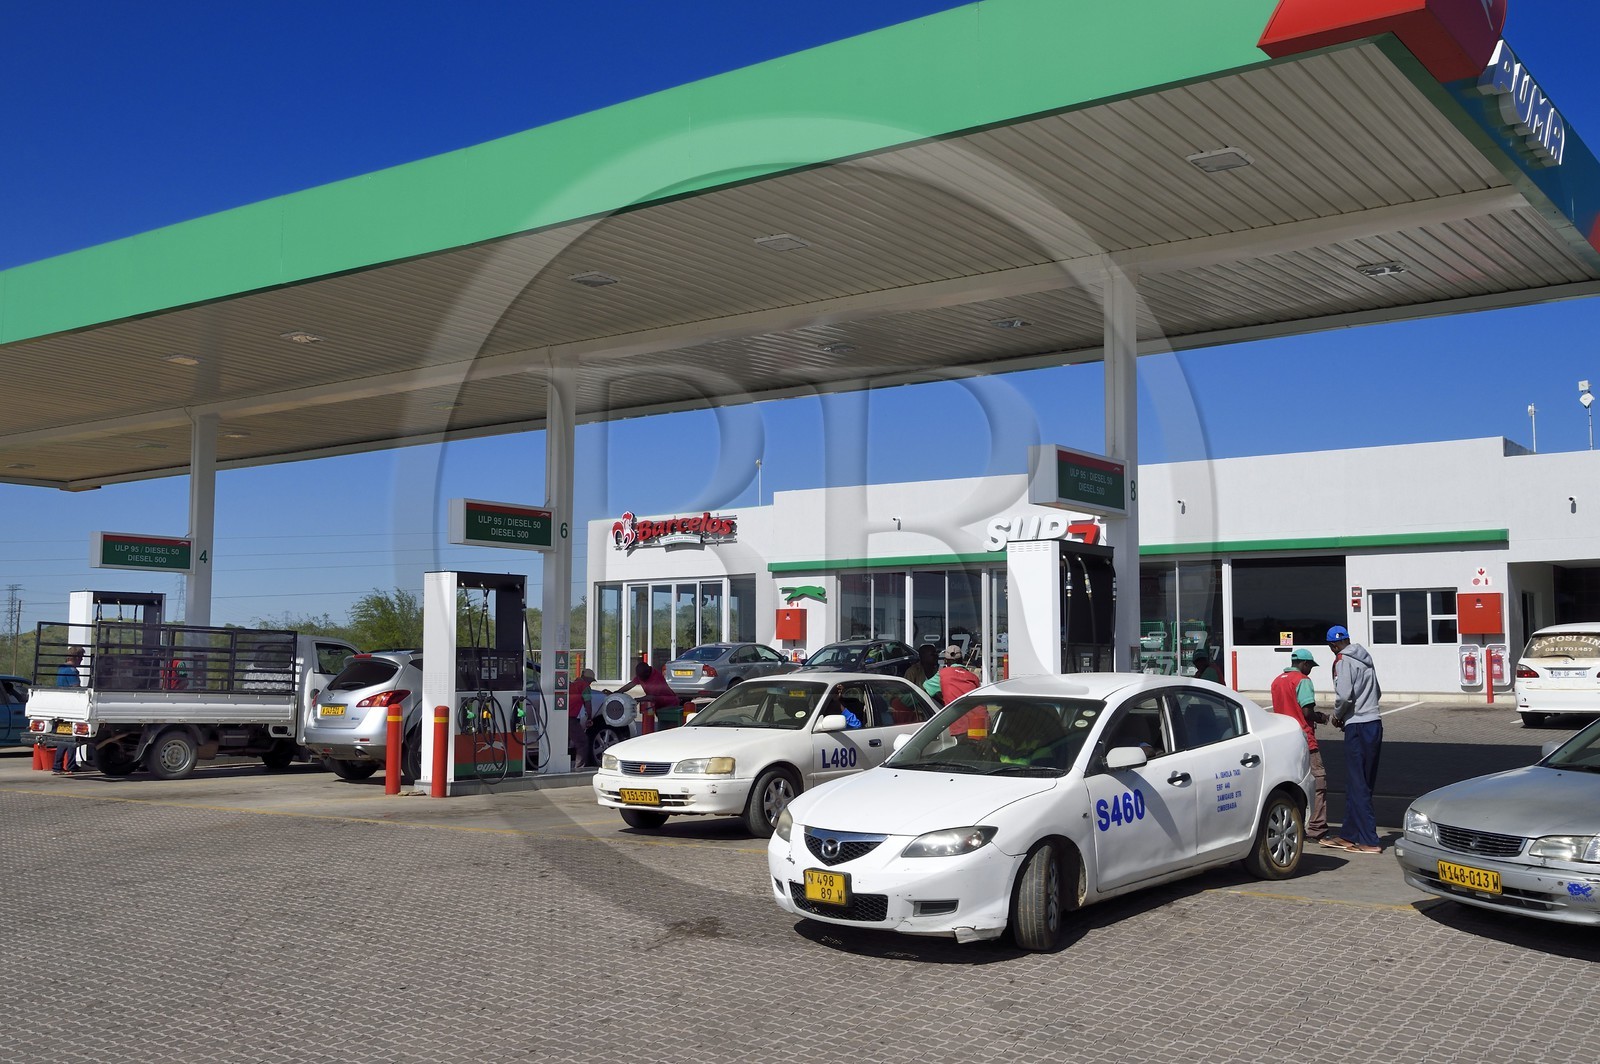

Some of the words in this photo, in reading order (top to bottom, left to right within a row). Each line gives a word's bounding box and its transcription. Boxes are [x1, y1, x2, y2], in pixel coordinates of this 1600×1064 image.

[1069, 467, 1080, 478] ULP
[1089, 472, 1106, 484] DIESEL
[1106, 476, 1113, 485] 50
[1078, 482, 1096, 494] DIESEL
[1096, 485, 1105, 496] 500
[1130, 480, 1136, 501] 8
[478, 515, 492, 524] ULP
[493, 517, 502, 525] 95
[507, 518, 532, 528] DIESEL
[533, 521, 541, 529] 50
[636, 512, 735, 541] Barcelos
[490, 528, 516, 538] DIESEL
[517, 530, 529, 539] 500
[560, 522, 568, 539] 6
[115, 544, 129, 552] ULP
[130, 545, 139, 553] 95
[145, 546, 170, 554] DIESEL
[199, 549, 208, 564] 4
[127, 554, 153, 562] DIESEL
[1531, 635, 1578, 651] KATOSI
[821, 747, 857, 769] L480
[1096, 788, 1145, 832] S460
[817, 874, 834, 887] 498
[820, 887, 832, 900] 89
